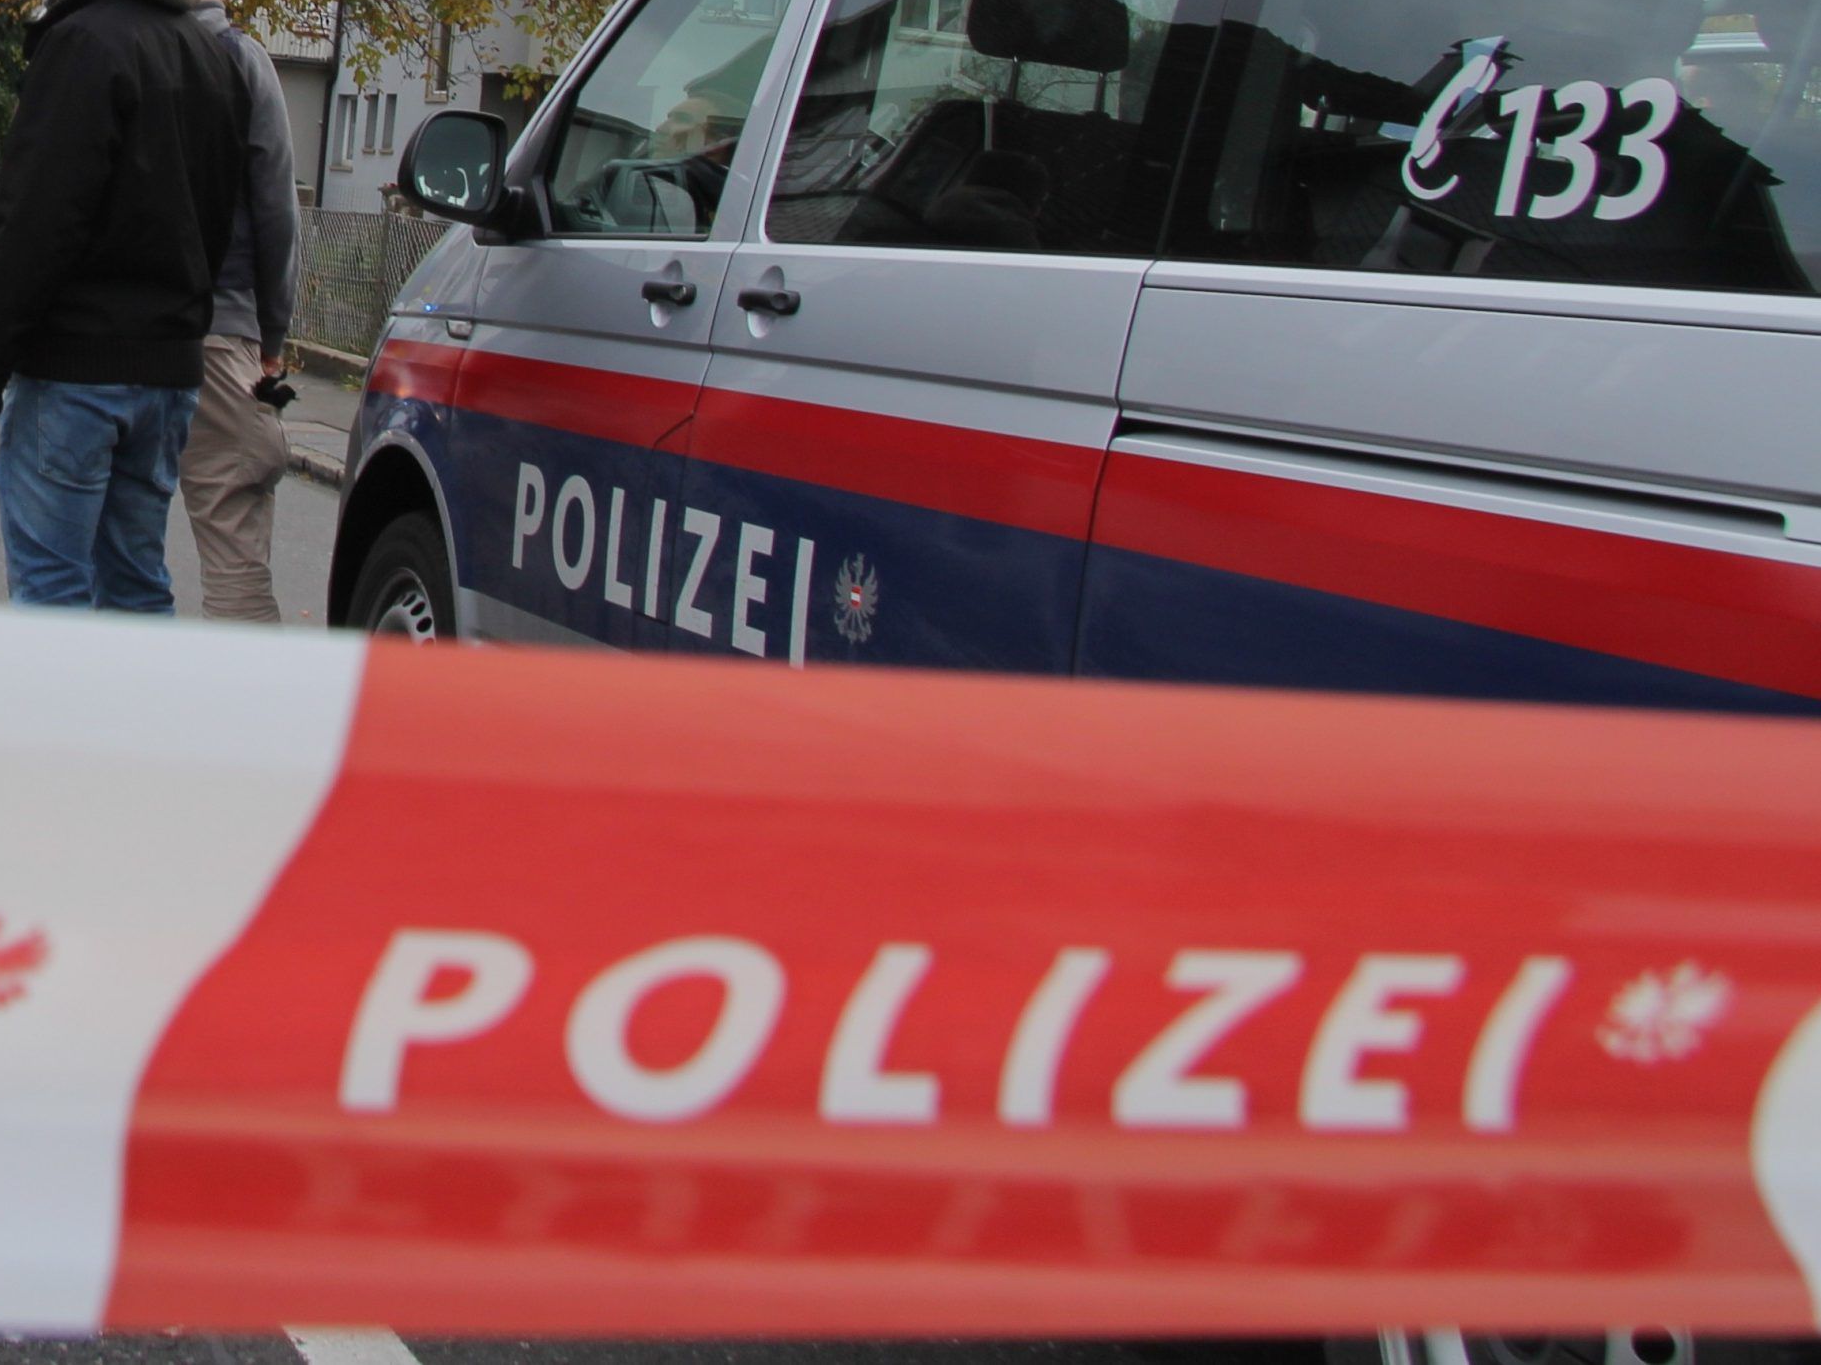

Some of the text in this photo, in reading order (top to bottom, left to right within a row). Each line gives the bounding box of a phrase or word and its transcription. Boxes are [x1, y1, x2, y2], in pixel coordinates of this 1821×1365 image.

[1494, 77, 1679, 221] 133
[512, 461, 815, 670] POLIZEI
[337, 928, 1574, 1134] POLIZEI
